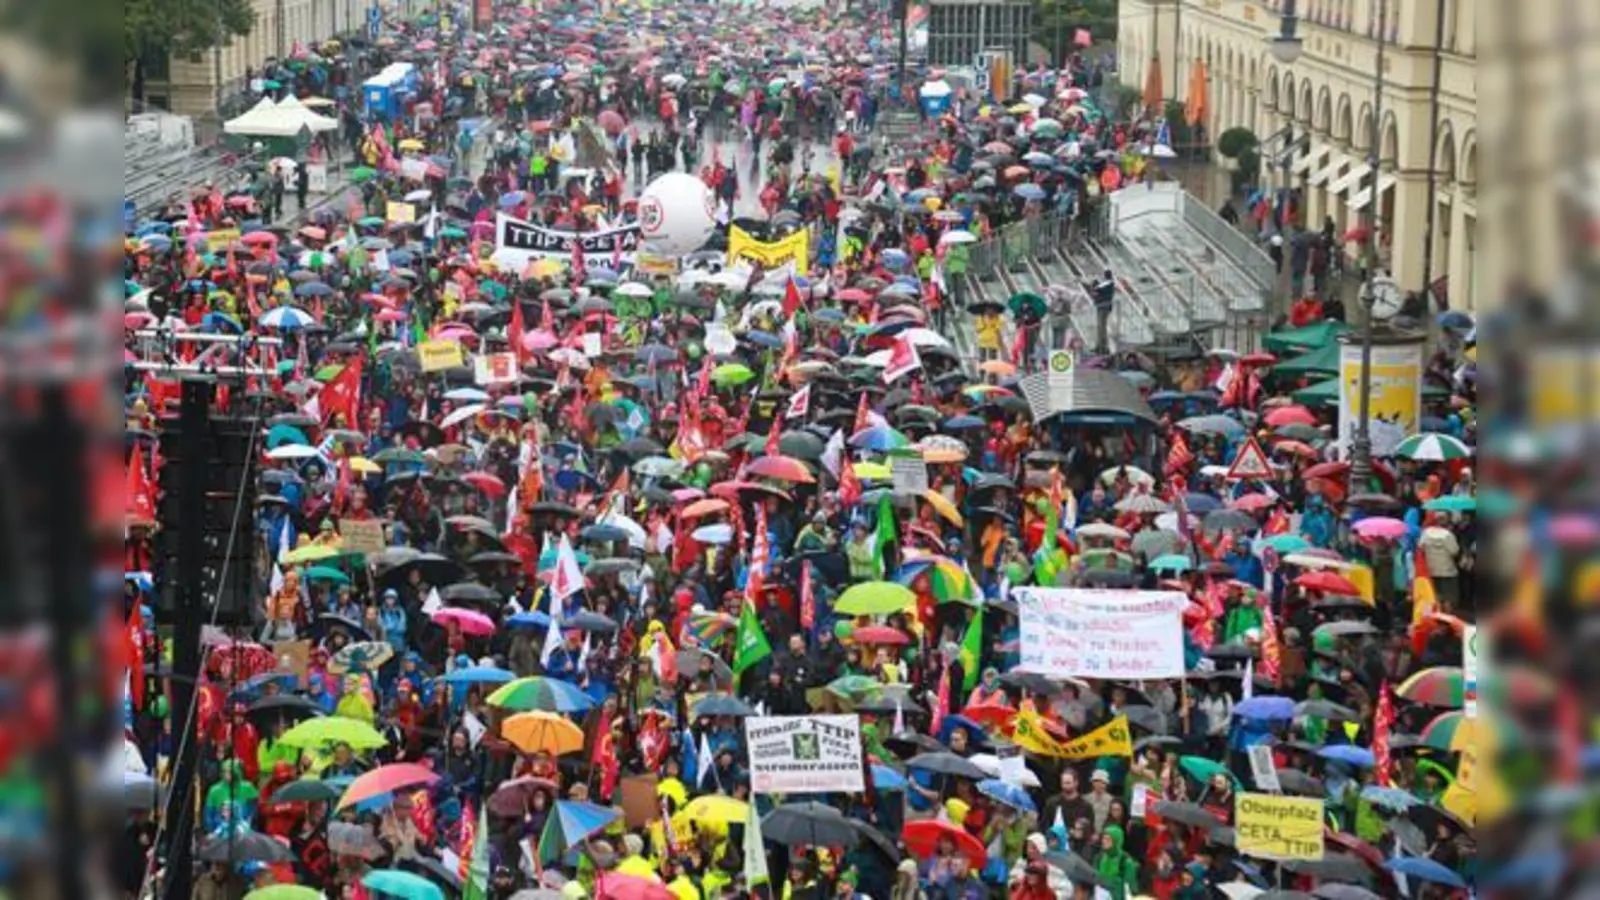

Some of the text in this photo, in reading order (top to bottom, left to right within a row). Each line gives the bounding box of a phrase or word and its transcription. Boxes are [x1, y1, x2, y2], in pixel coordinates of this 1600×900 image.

[509, 226, 558, 248] TTIP
[808, 718, 855, 740] TTIP
[1241, 799, 1318, 822] Oberpfalz
[1239, 822, 1320, 857] CETA TTIP
